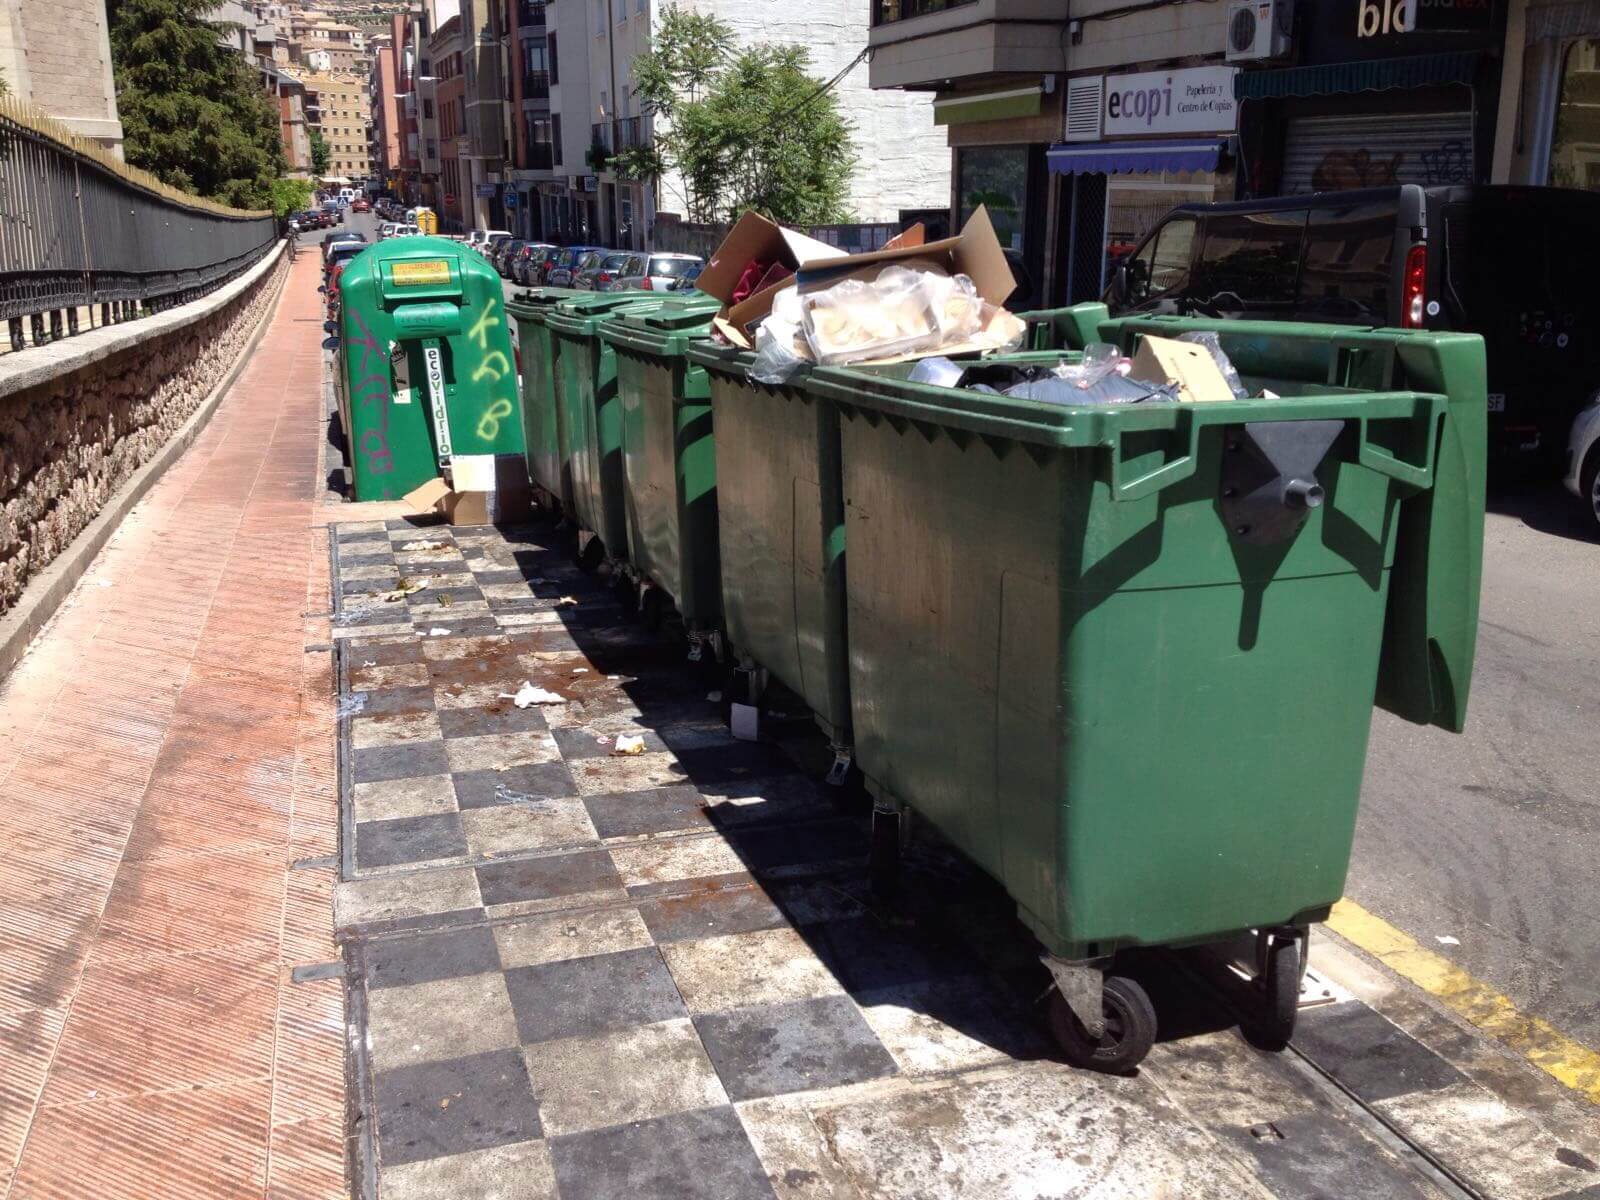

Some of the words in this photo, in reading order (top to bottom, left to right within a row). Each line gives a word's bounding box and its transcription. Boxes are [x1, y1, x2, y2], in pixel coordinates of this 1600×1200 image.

[1108, 77, 1172, 126] ecopi
[1177, 102, 1199, 113] Centro
[1200, 102, 1209, 112] de
[1209, 99, 1233, 113] Copias
[1218, 85, 1224, 96] y
[428, 350, 450, 454] ecovidrio
